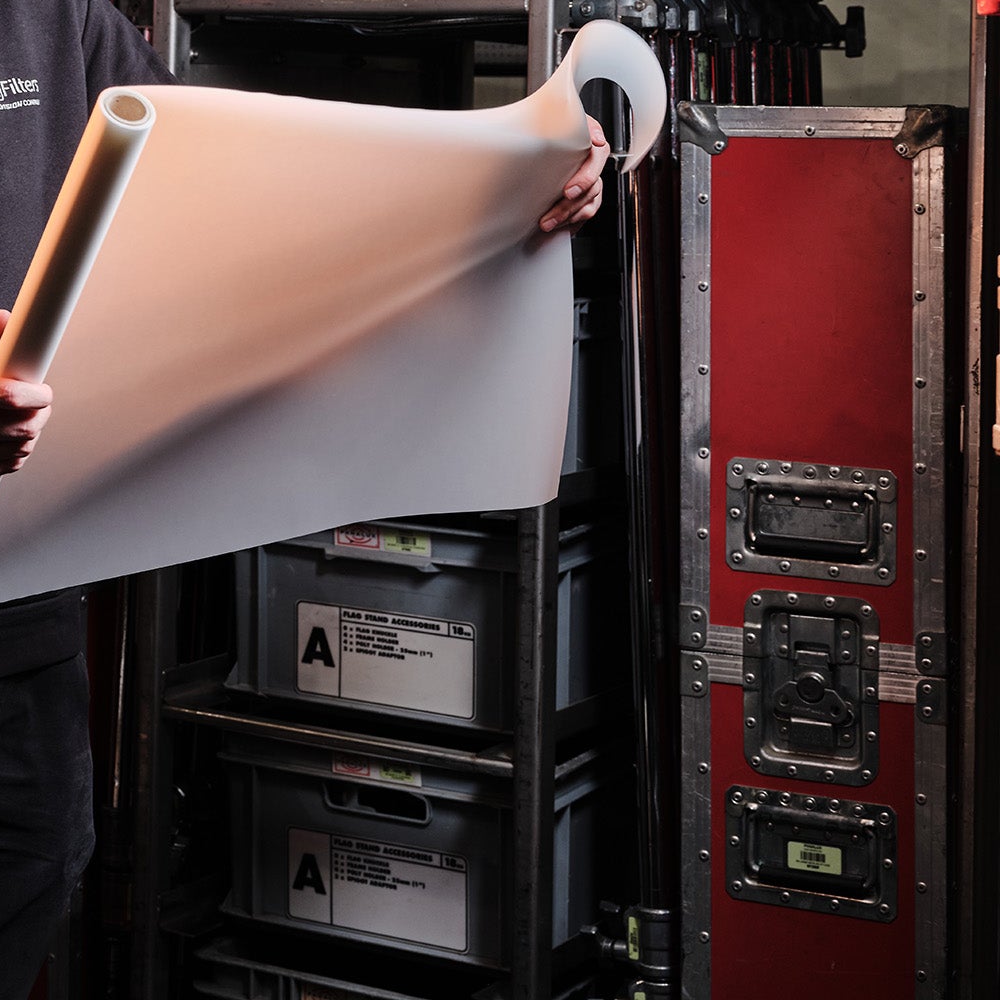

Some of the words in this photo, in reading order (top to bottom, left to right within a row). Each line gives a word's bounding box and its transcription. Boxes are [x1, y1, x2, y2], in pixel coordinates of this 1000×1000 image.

[343, 611, 362, 620] FLAG
[364, 614, 389, 624] STAND
[391, 618, 441, 631] ACCESSORIES
[301, 626, 335, 668] A
[356, 842, 380, 853] STAND
[383, 846, 433, 862] ACCESSORIES
[292, 853, 327, 895] A
